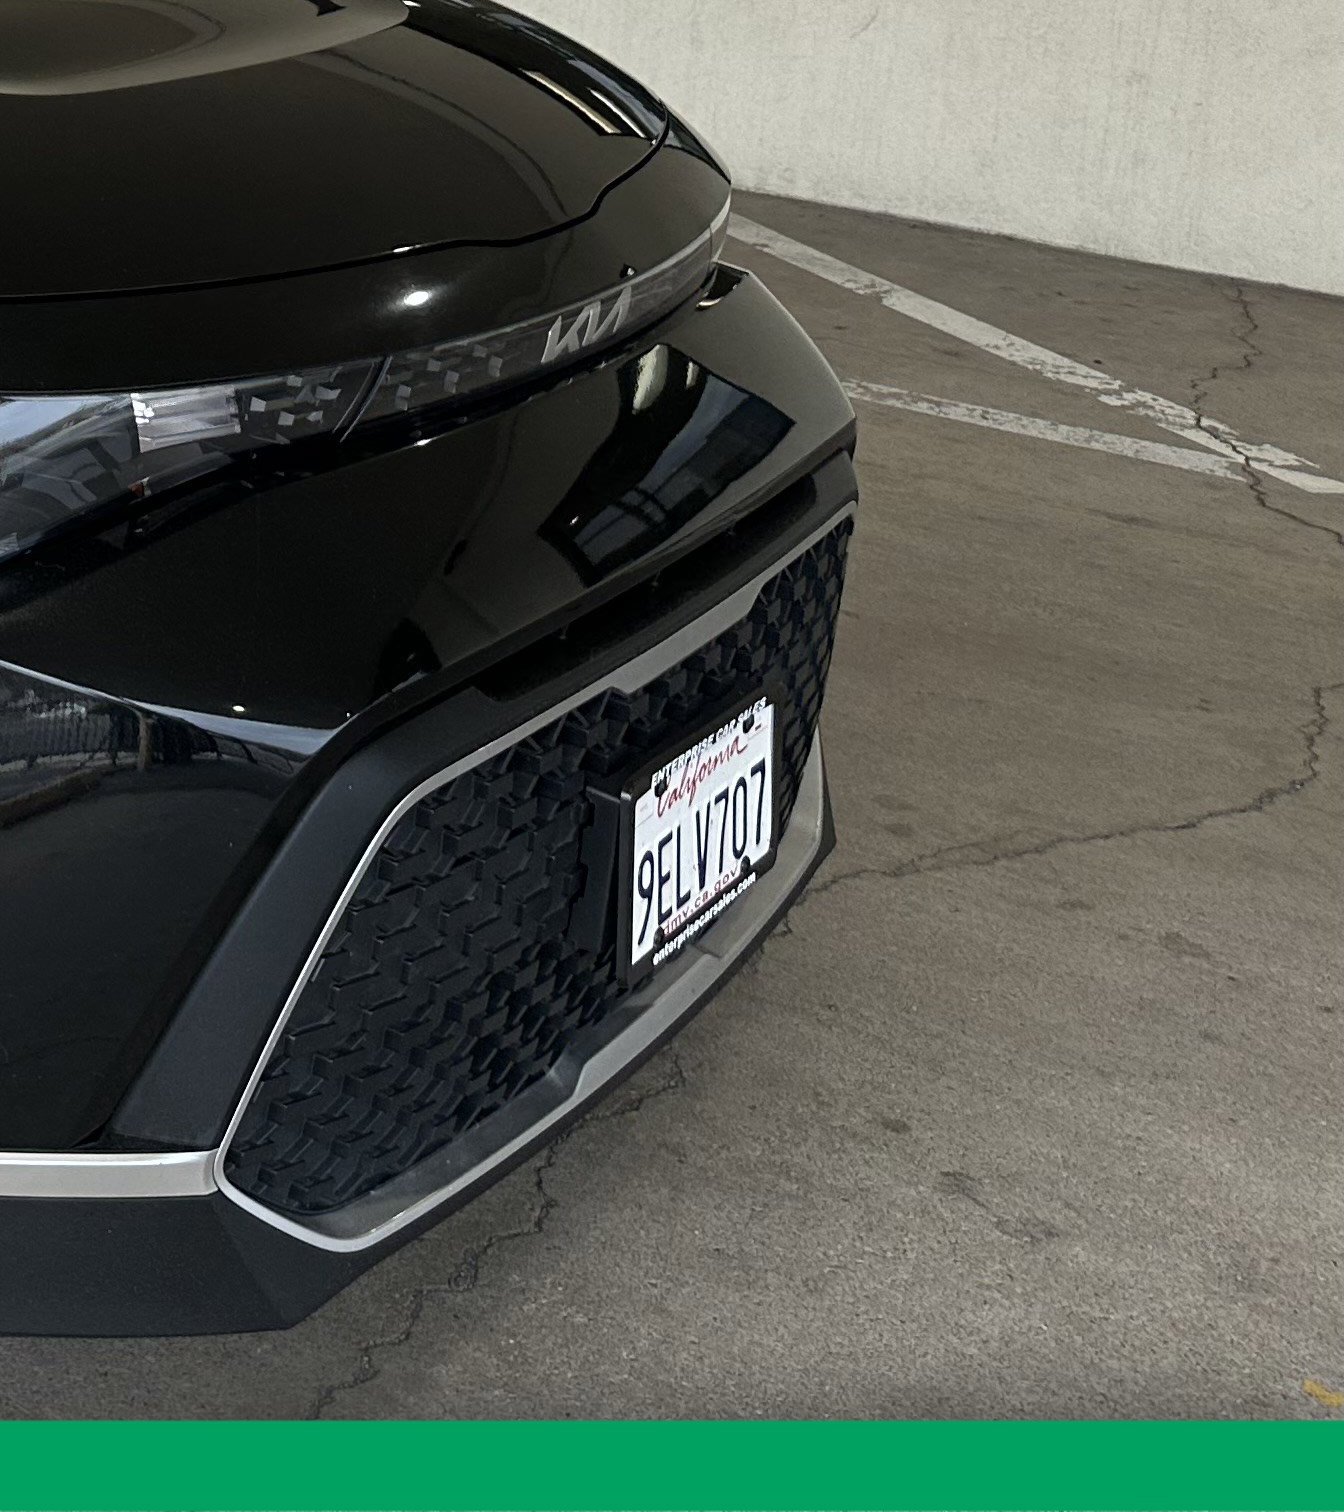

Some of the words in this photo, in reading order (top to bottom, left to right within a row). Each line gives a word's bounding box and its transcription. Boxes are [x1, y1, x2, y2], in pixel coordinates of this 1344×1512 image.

[652, 733, 716, 785] ENTERPRISE
[658, 735, 748, 818] California
[638, 757, 766, 946] 9ELV707
[653, 872, 756, 966] enterprisecarsales.com
